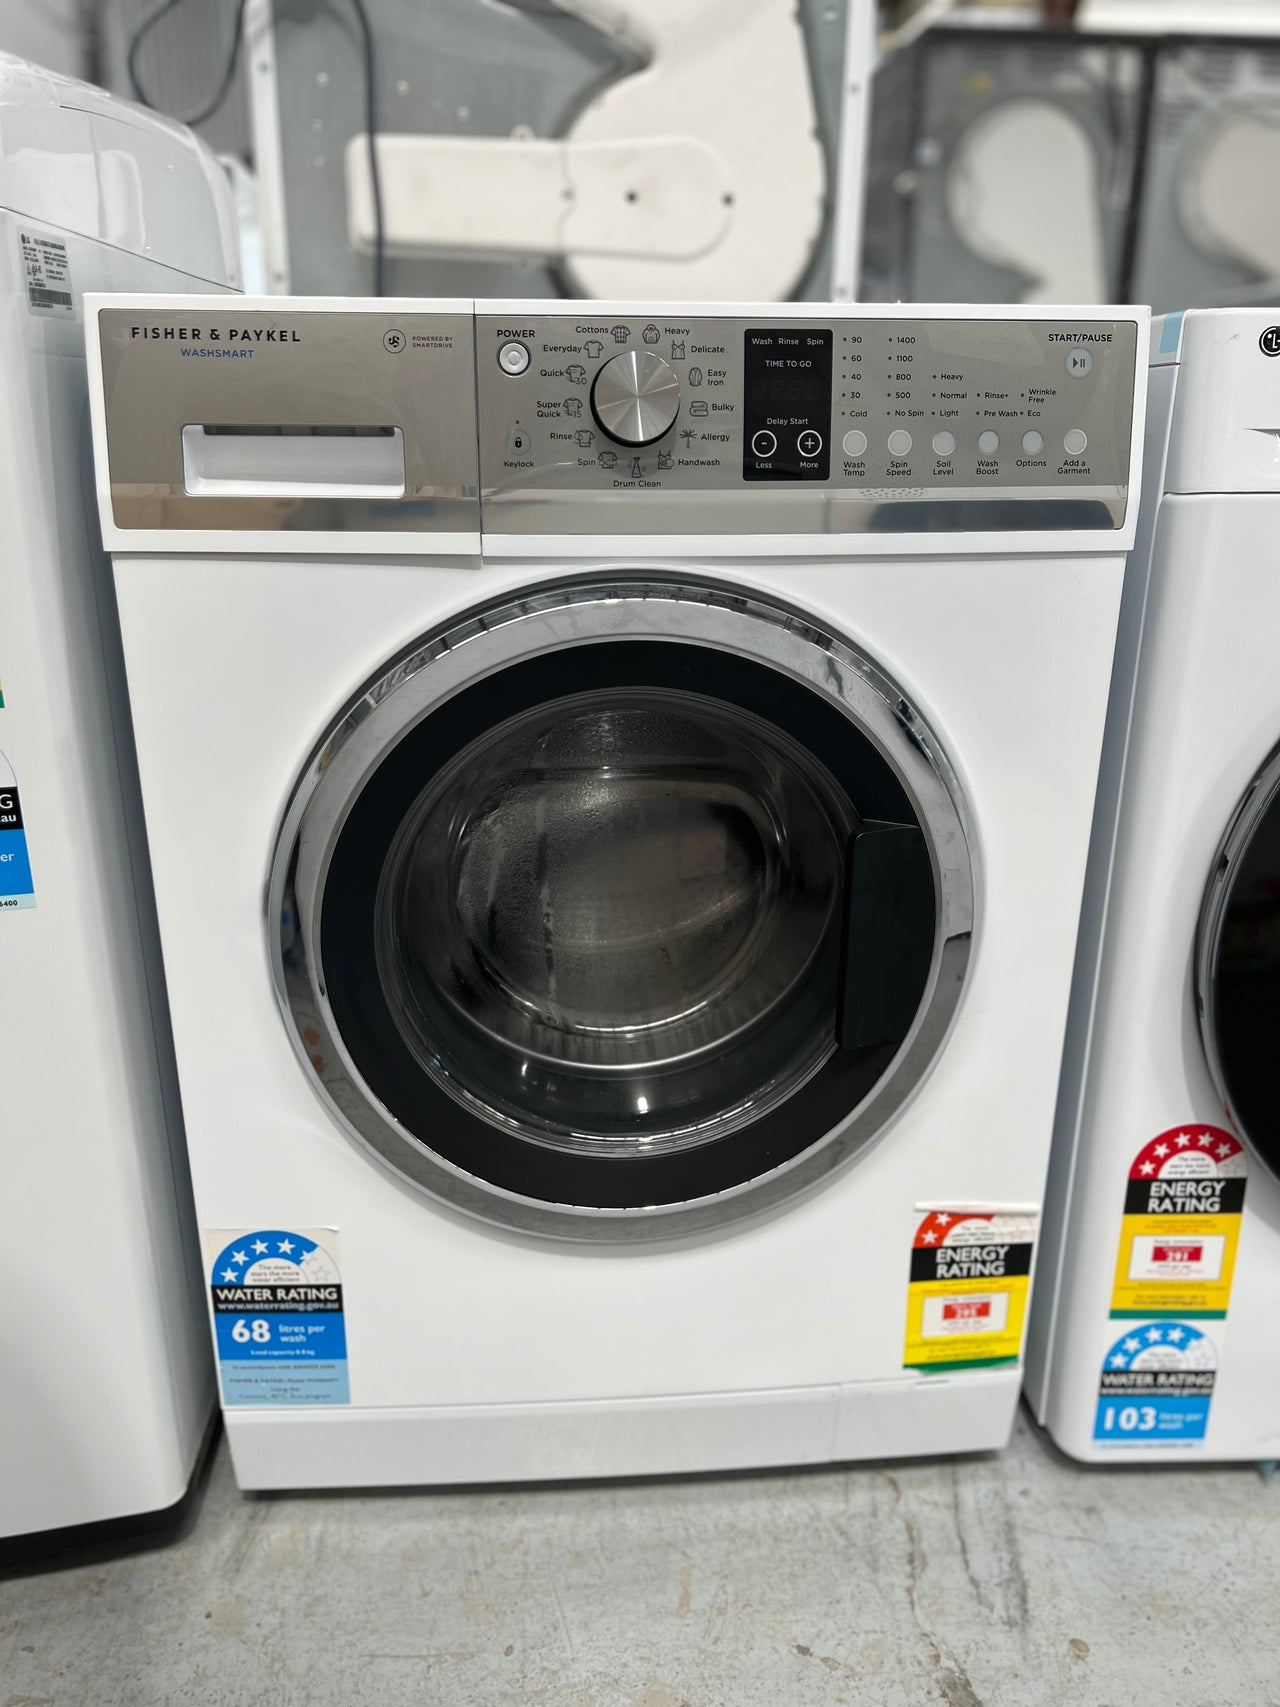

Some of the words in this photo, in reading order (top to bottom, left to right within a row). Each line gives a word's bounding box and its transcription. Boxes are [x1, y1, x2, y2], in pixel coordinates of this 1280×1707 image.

[496, 329, 536, 338] POWER
[575, 325, 609, 334] Cottons
[664, 327, 691, 336] Heavy
[131, 326, 202, 341] FISHER
[209, 328, 221, 341] &
[229, 328, 301, 342] PAYKEL
[1048, 333, 1113, 343] START/PAUSE
[751, 337, 773, 345] Wash
[778, 337, 800, 345] Rinse
[806, 337, 824, 346] Spin
[851, 336, 862, 344] 90
[896, 336, 916, 344] 1400
[180, 347, 254, 359] WASHSMART
[543, 344, 582, 354] Everyday
[690, 345, 725, 354] Delicate
[765, 360, 785, 368] TIME
[786, 360, 798, 368] TO
[799, 360, 812, 368] GO
[540, 369, 565, 378] Quick
[707, 369, 727, 379] Easy
[850, 373, 862, 381] 40
[895, 373, 912, 381] 800
[940, 373, 964, 382] Heavy
[940, 391, 968, 399] Normal
[1028, 388, 1057, 396] Wrinkle
[536, 400, 561, 409] Super
[712, 403, 735, 412] Bulky
[536, 410, 561, 418] Quick
[907, 410, 924, 418] Spin
[939, 410, 959, 418] Light
[766, 417, 788, 425] Delay
[790, 417, 809, 425] Start
[550, 432, 573, 440] Rinse
[700, 433, 731, 442] Allergy
[503, 460, 534, 468] Keylock
[577, 458, 596, 466] Spin
[755, 461, 773, 469] Less
[800, 461, 819, 469] More
[843, 461, 866, 469] Wash
[890, 460, 908, 468] Spin
[936, 460, 951, 468] Soil
[977, 460, 999, 468] Wash
[1016, 459, 1047, 468] Options
[1063, 459, 1079, 467] Add
[843, 469, 866, 477] Temp
[886, 469, 912, 477] Speed
[933, 468, 954, 476] Level
[976, 467, 999, 475] Boost
[1057, 467, 1091, 475] Garment
[1150, 1180, 1226, 1197] ENERGY
[1147, 1197, 1221, 1213] RATING
[936, 1244, 1010, 1263] ENERGY
[936, 1260, 1006, 1279] RATING
[216, 1288, 273, 1301] WATER
[276, 1288, 338, 1300] RATING
[217, 1301, 339, 1311] www.waterrating.gov.au
[231, 1319, 271, 1344] 68
[278, 1324, 305, 1333] litres
[308, 1324, 326, 1335] per
[280, 1334, 307, 1343] wash
[1102, 1372, 1155, 1387] WATER
[1156, 1372, 1214, 1387] RATING
[1103, 1406, 1157, 1431] 103
